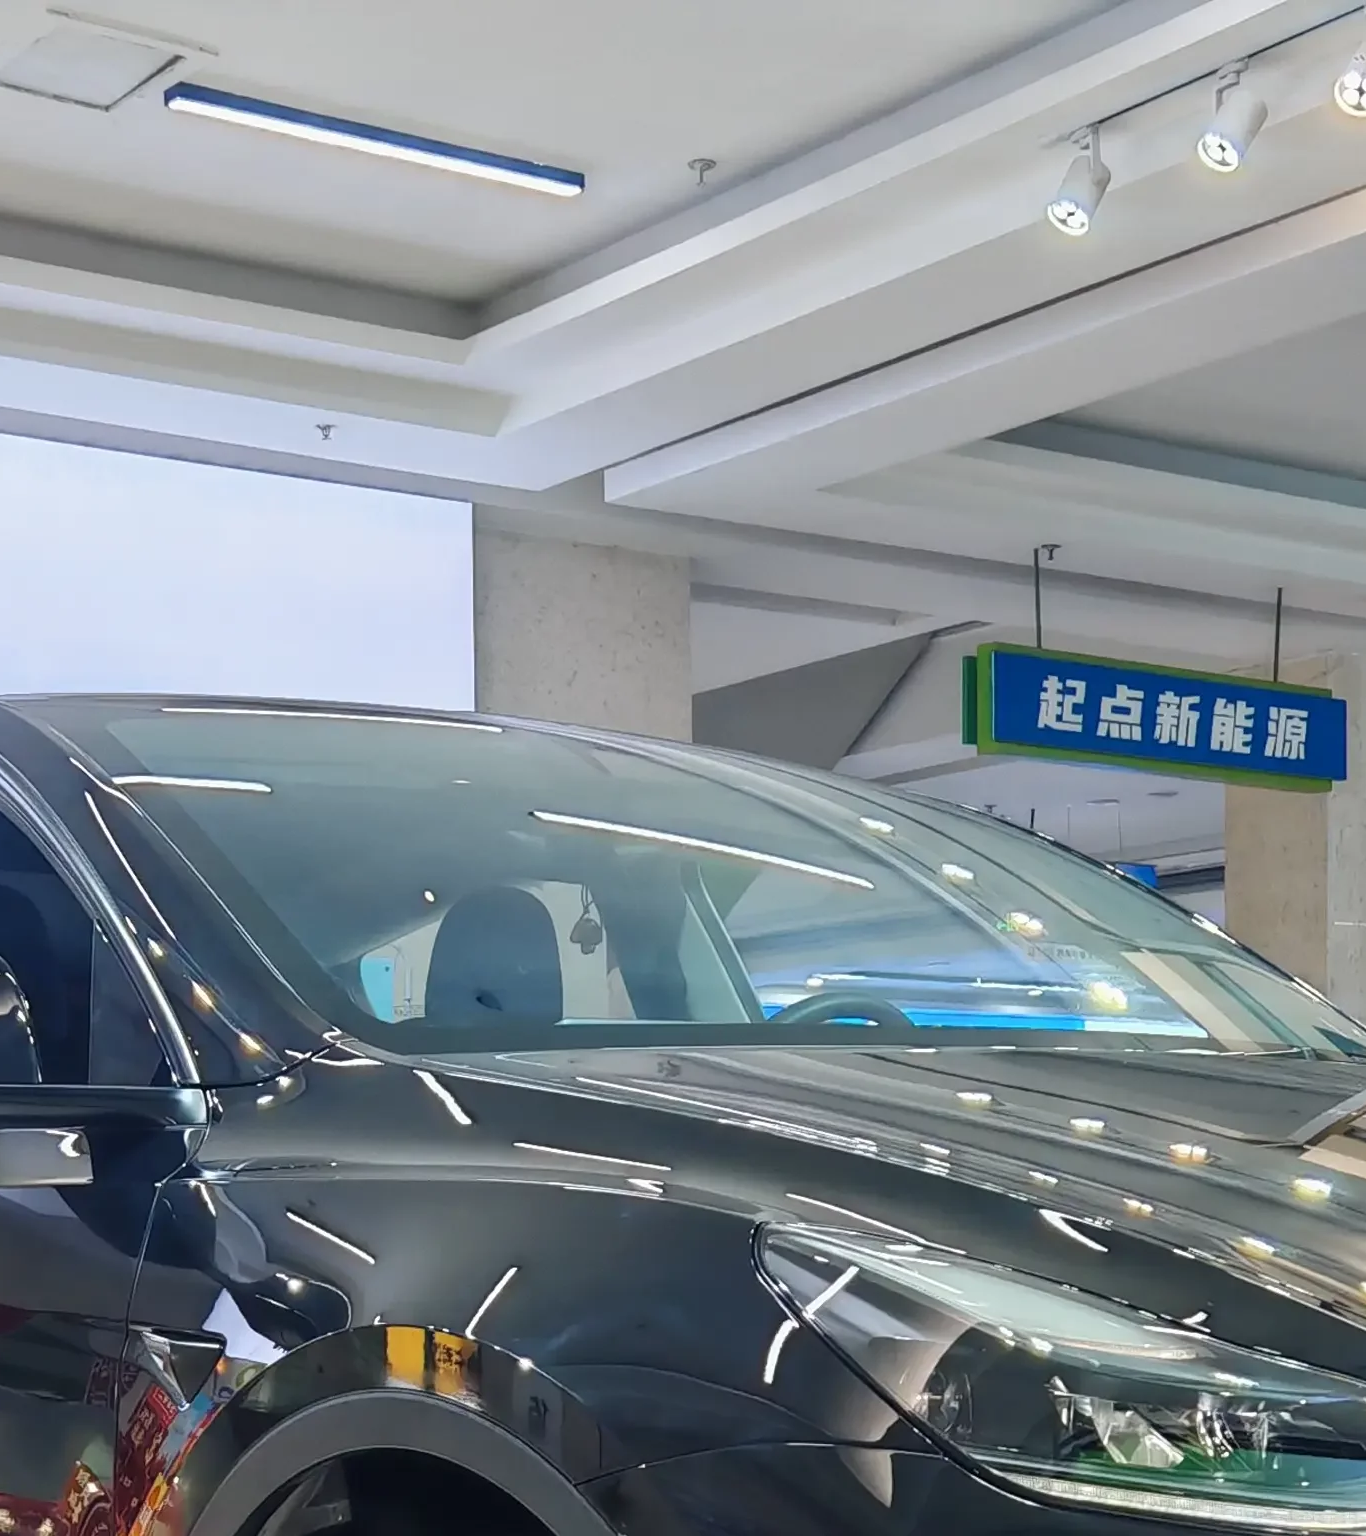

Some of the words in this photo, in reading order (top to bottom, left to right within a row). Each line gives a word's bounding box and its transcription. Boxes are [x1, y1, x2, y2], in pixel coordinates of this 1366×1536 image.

[1037, 675, 1309, 761] 起点新能源
